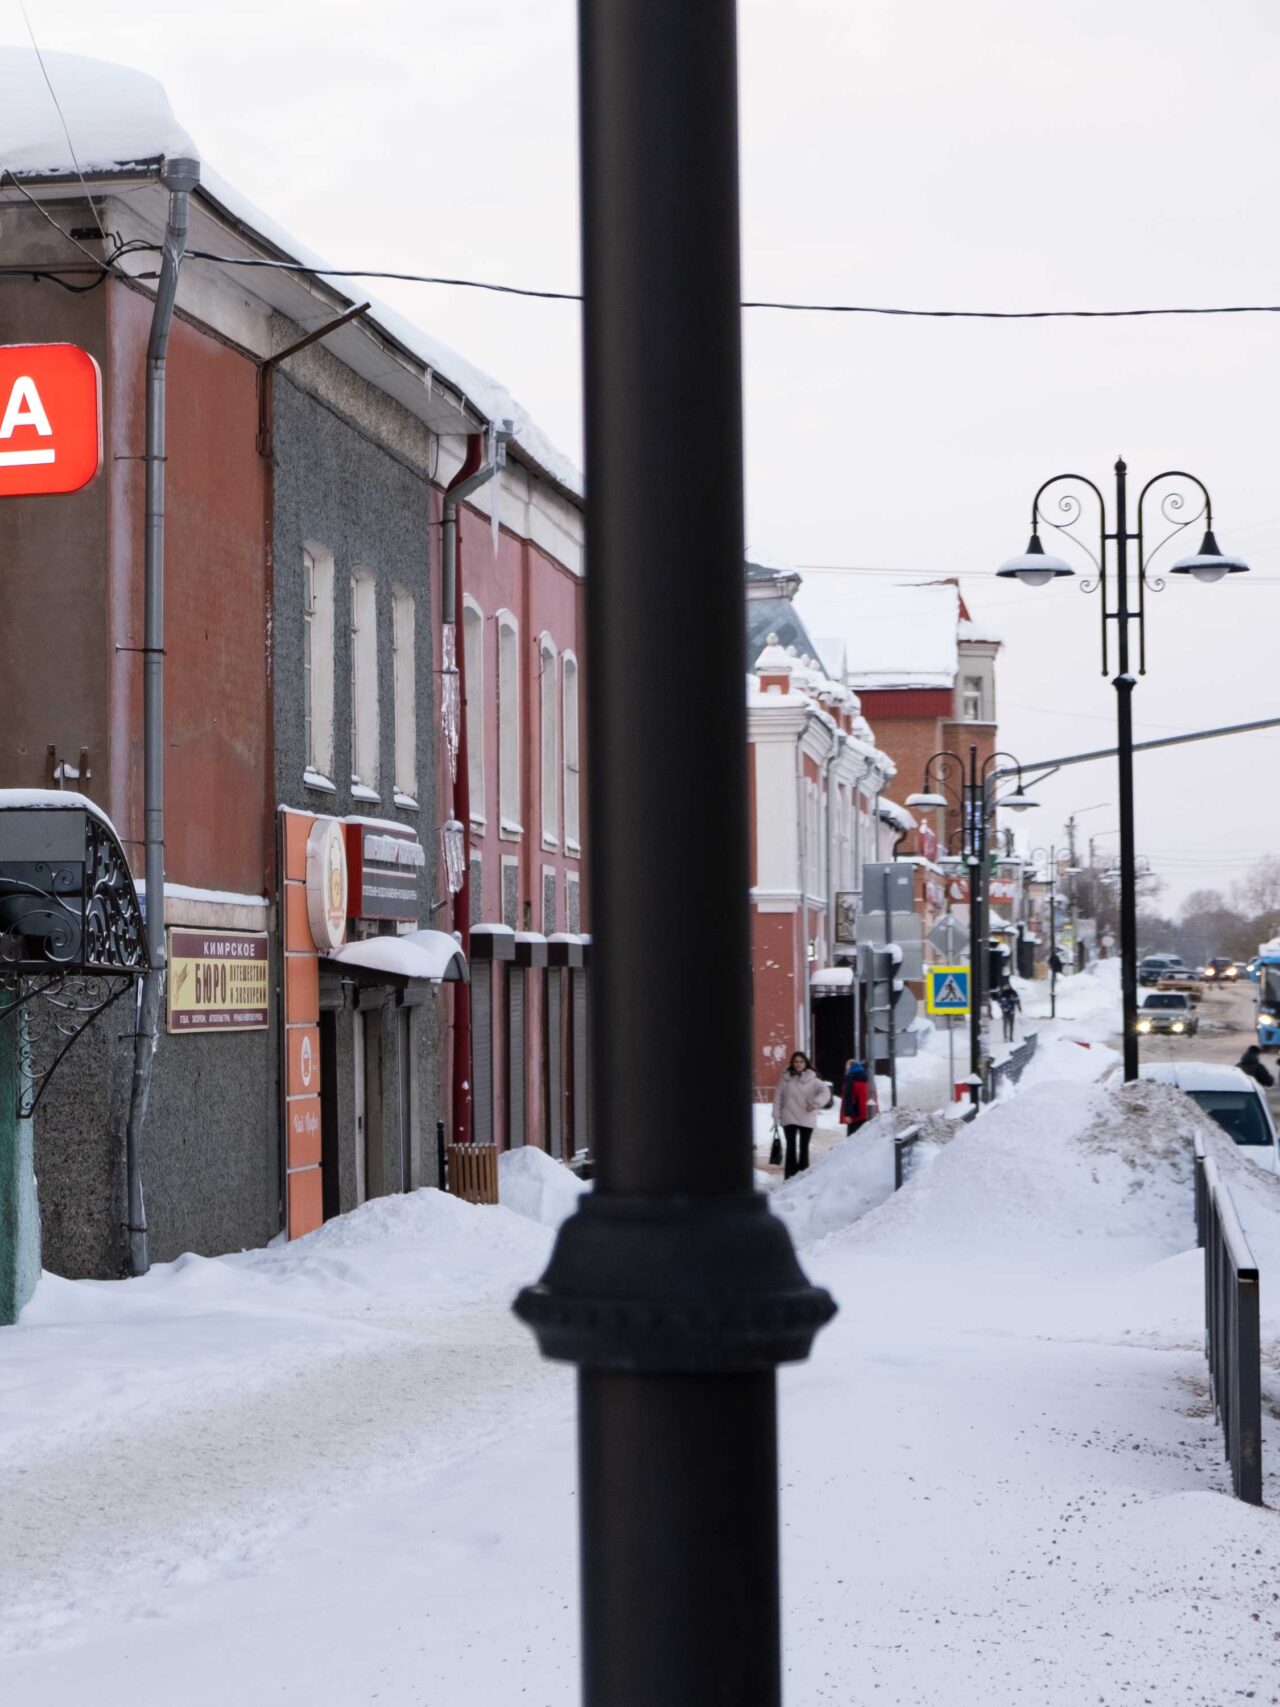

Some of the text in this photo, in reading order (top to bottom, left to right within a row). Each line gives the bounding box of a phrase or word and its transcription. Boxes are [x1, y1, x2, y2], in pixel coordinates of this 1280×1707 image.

[203, 941, 256, 957] КИМРСКОЕ
[229, 963, 266, 982] ПУТЕШЕСТВИЙ
[195, 963, 227, 1005] БЮРО
[230, 986, 234, 1004] И
